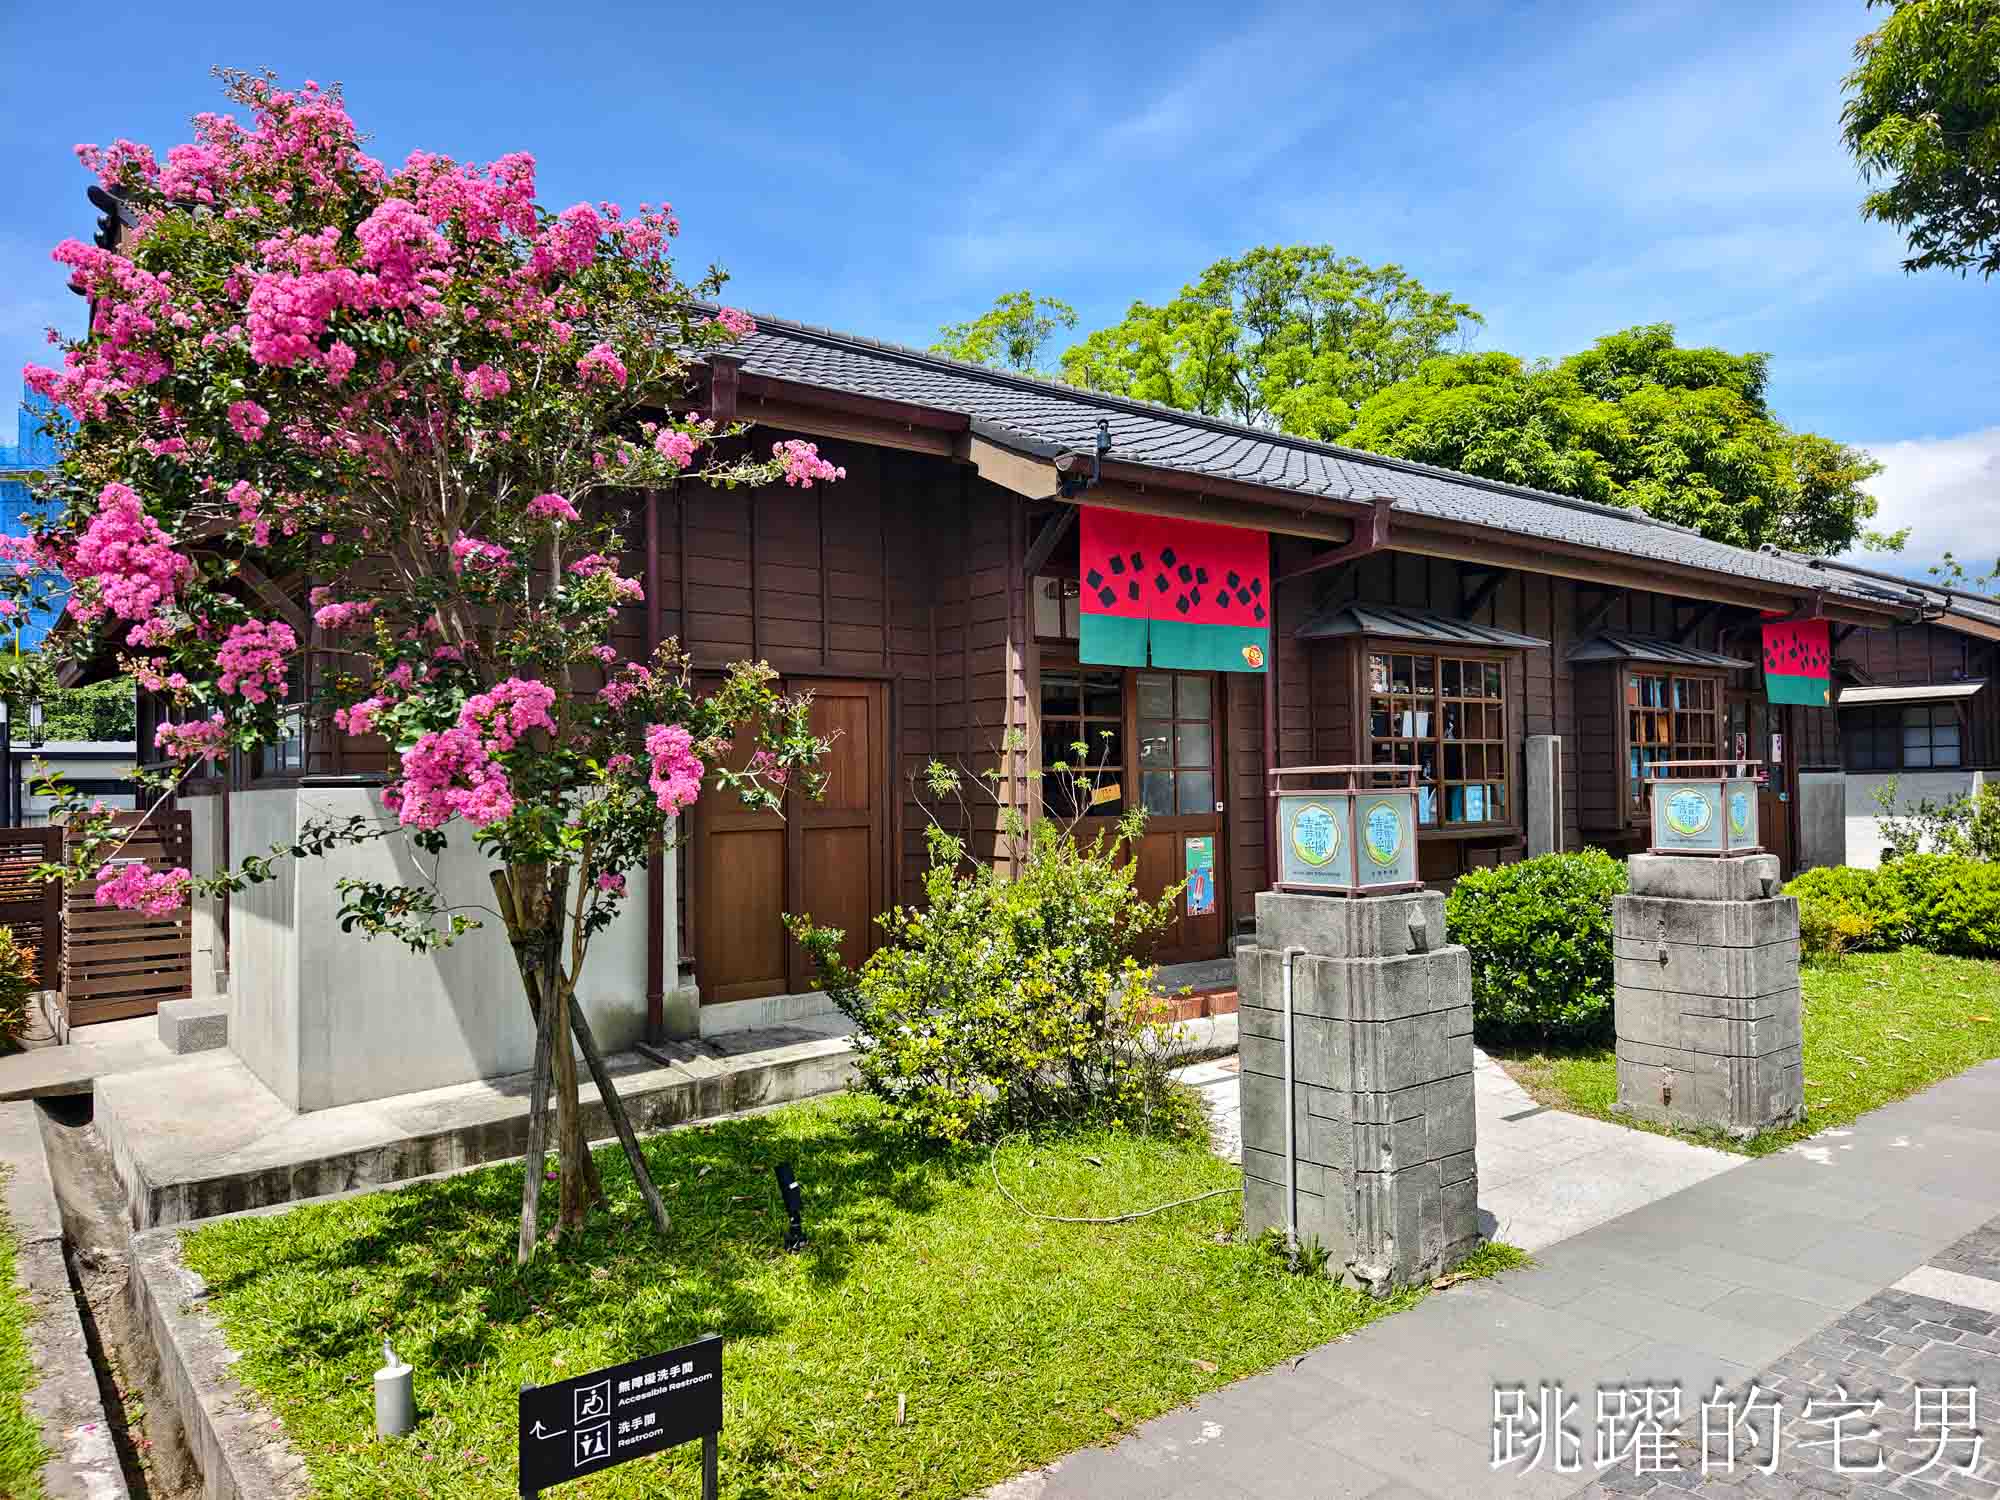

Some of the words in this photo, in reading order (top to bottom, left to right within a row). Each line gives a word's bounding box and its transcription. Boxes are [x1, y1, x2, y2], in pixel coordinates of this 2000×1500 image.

[618, 1361, 693, 1393] 無障礙洗手間
[618, 1386, 668, 1407] Accessible
[669, 1373, 712, 1391] Restroom
[618, 1412, 656, 1434] 洗手間
[618, 1428, 663, 1448] Restroom
